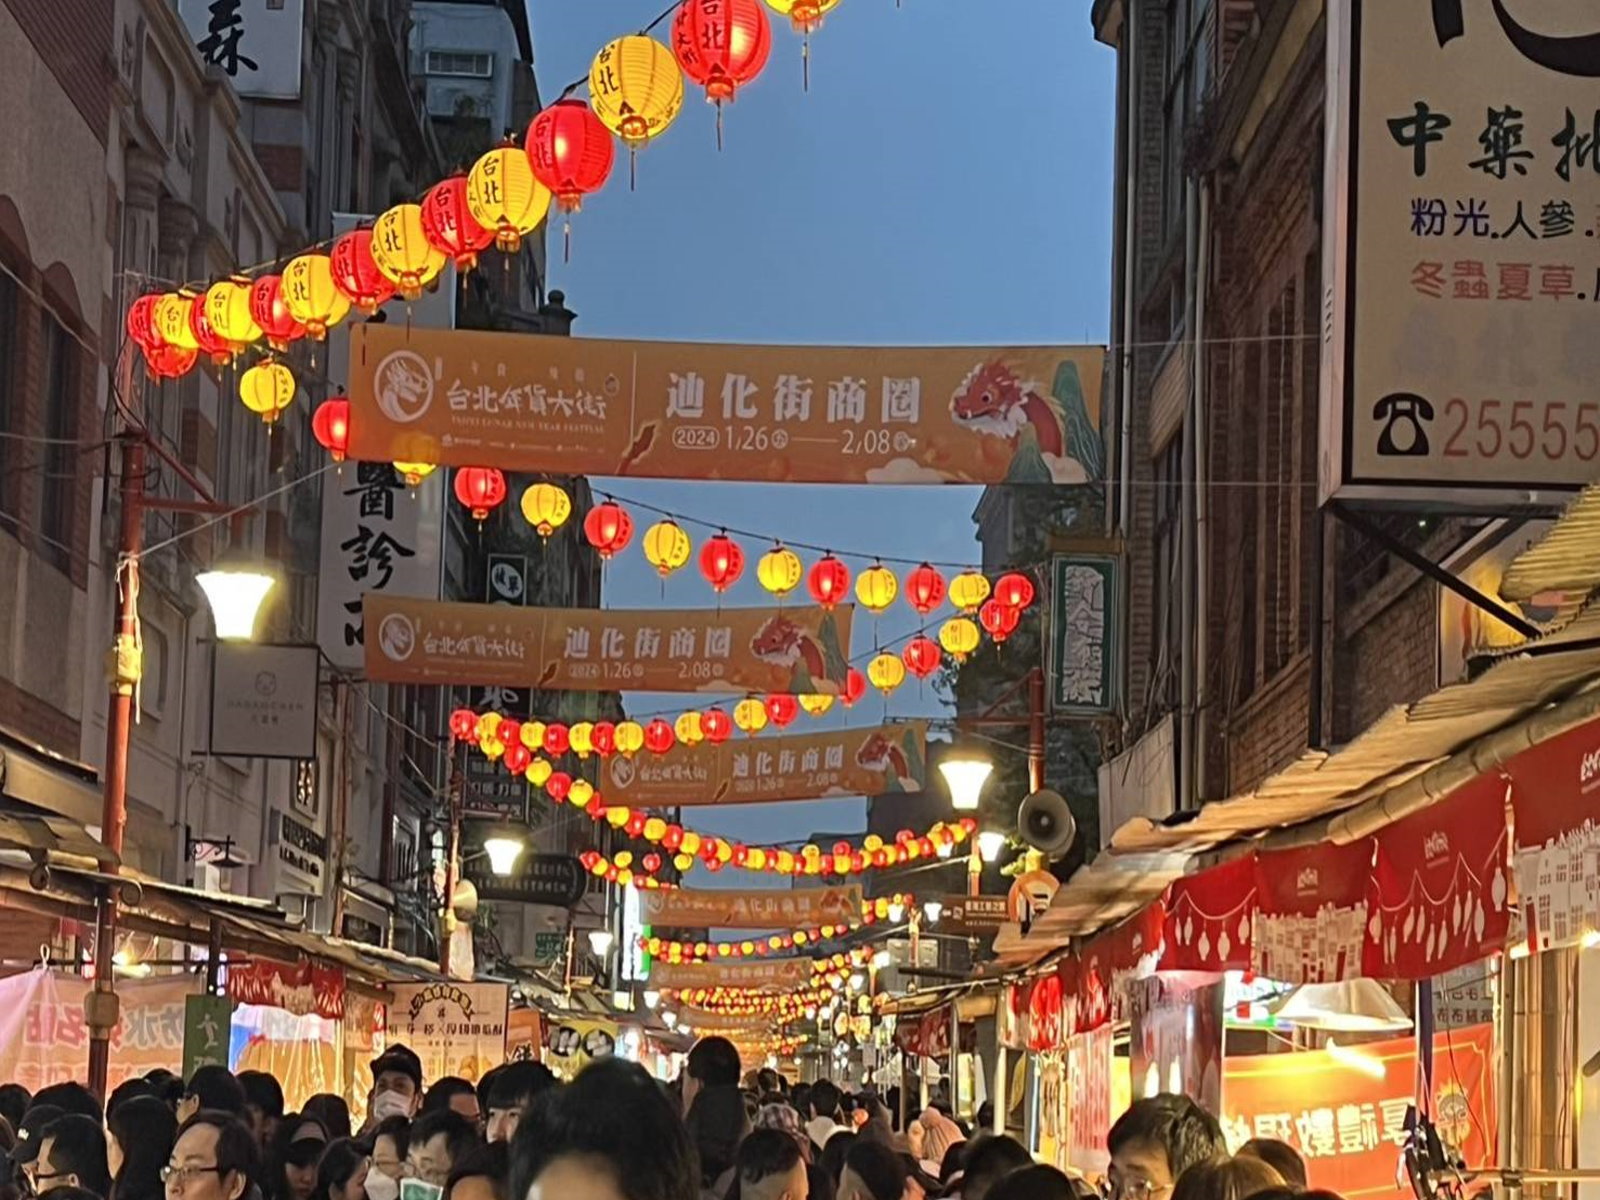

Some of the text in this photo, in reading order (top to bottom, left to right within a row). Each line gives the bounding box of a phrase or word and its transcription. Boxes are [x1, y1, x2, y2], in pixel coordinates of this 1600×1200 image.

[599, 43, 619, 95] 台北
[534, 115, 553, 169] 台北
[482, 156, 501, 205] 台北
[435, 186, 457, 233] 台北
[447, 378, 607, 420] 台北年貨大街
[666, 372, 920, 424] 迪化街商圈
[676, 429, 717, 446] 2024
[564, 626, 732, 660] 迪化街商圈
